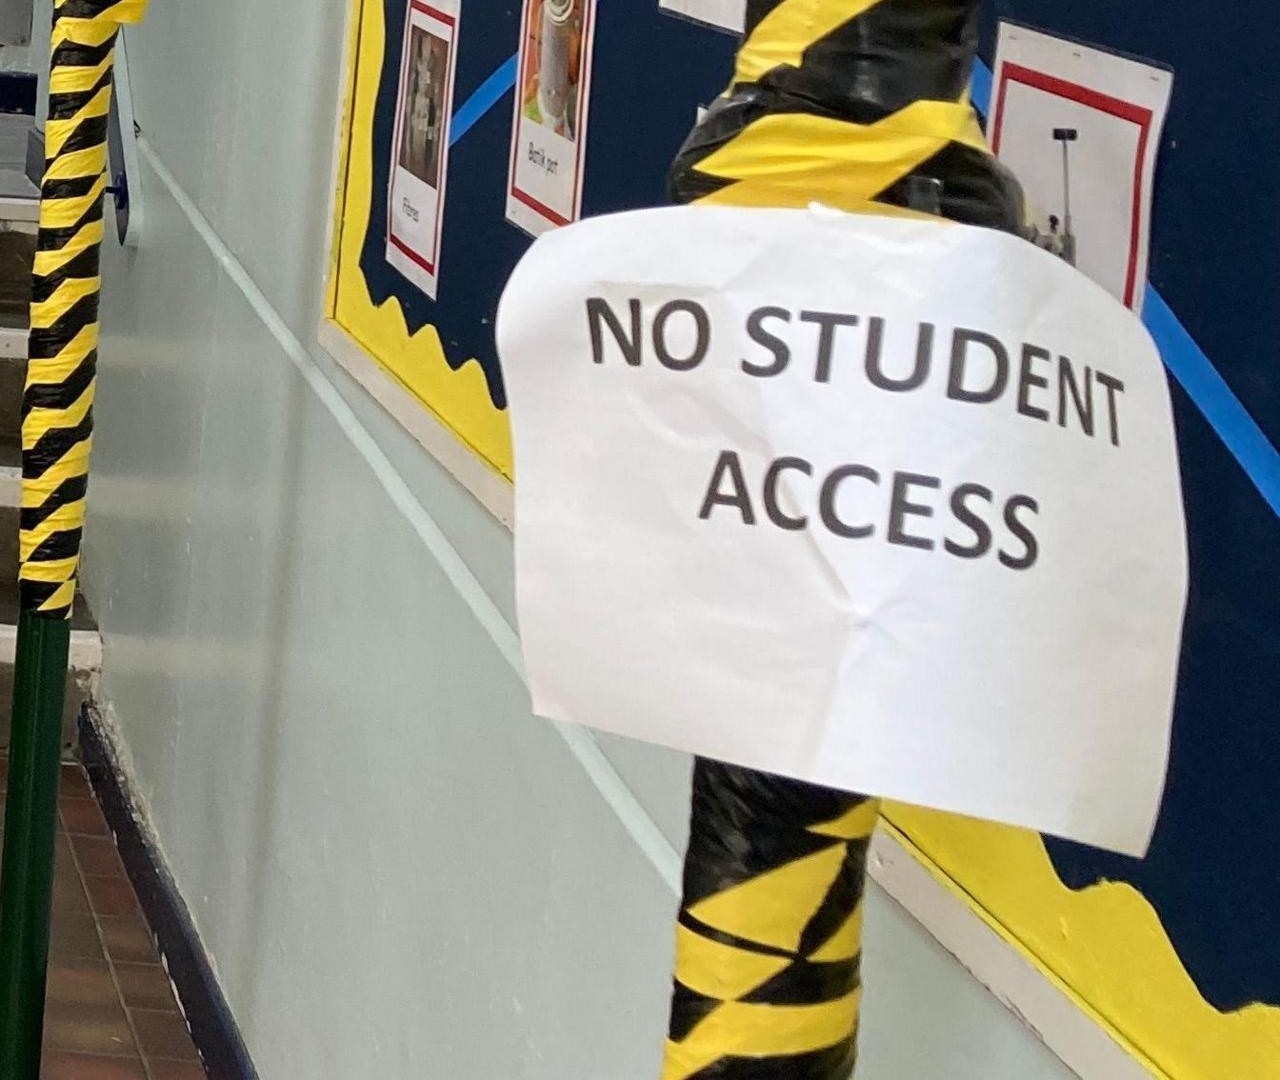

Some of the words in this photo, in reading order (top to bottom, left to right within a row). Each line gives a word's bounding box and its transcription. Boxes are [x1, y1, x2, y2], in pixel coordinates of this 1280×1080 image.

[585, 296, 712, 372] NO
[740, 305, 1125, 448] STUDENT
[697, 449, 1040, 571] ACCESS
